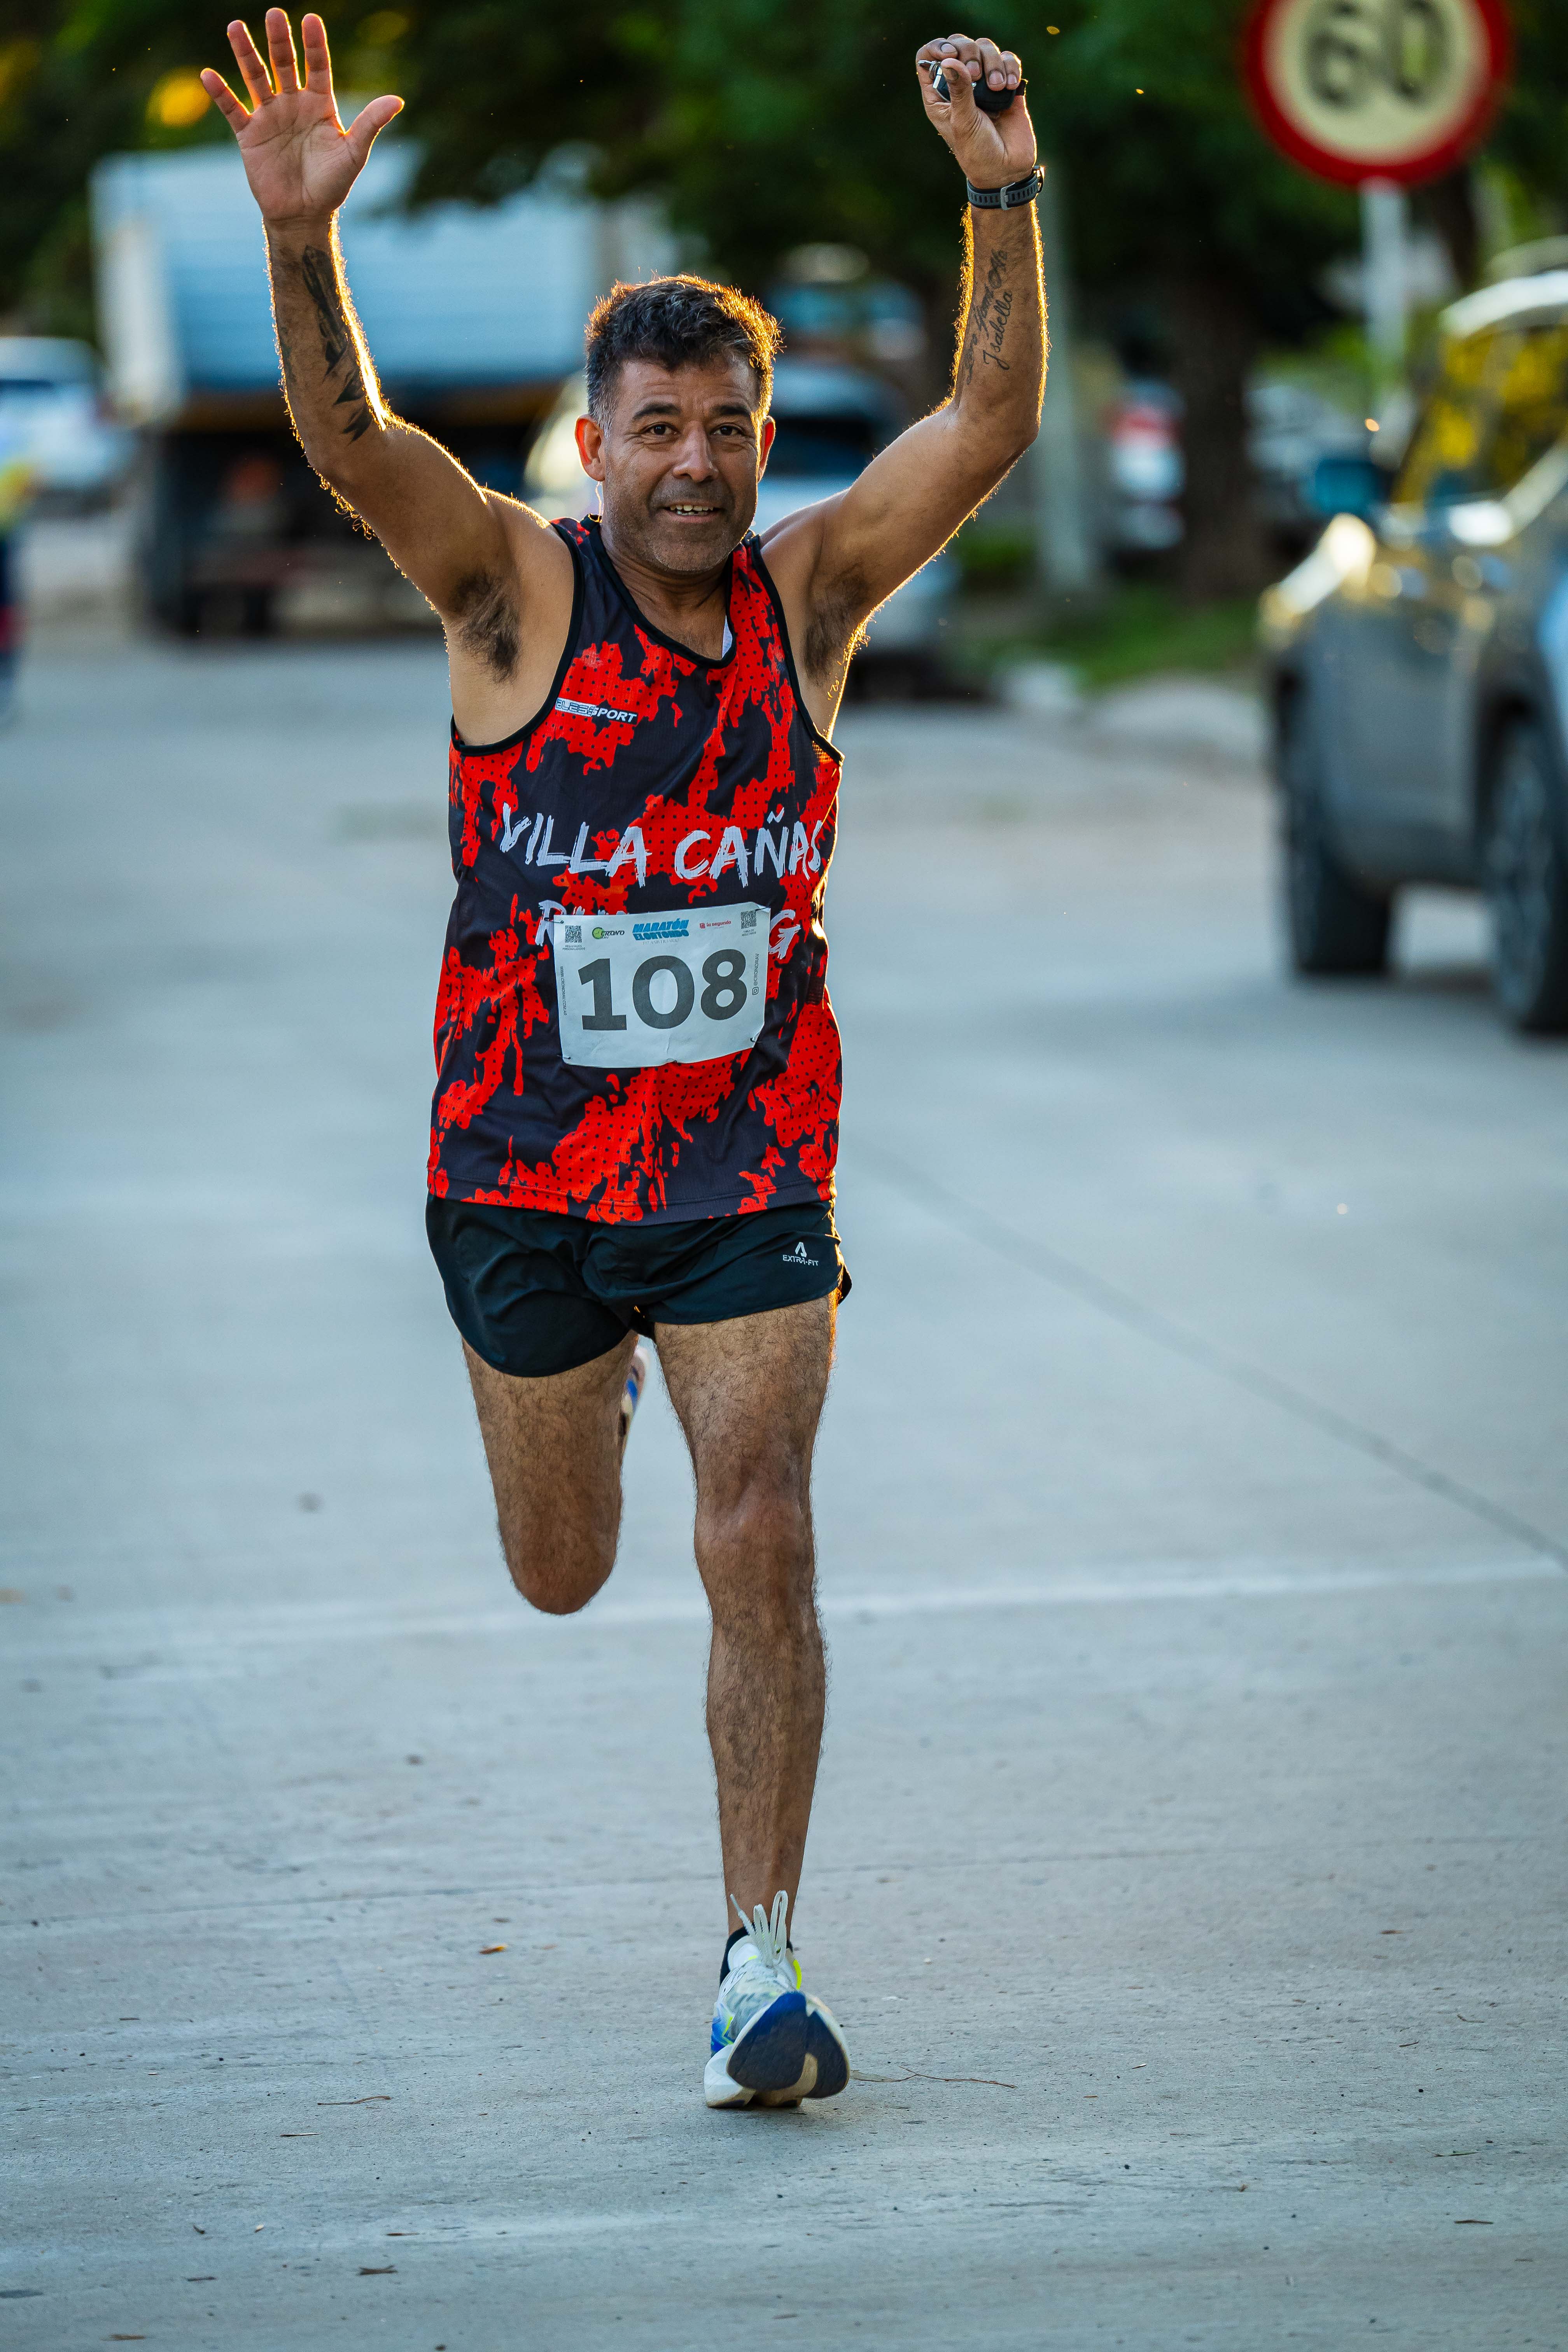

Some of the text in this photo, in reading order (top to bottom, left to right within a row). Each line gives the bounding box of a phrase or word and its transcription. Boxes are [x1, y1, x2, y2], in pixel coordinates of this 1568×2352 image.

[1301, 0, 1451, 113] 60
[500, 802, 823, 888] VILLA CAÑAS
[633, 918, 689, 933] MARATÓN
[578, 949, 747, 1031] 108
